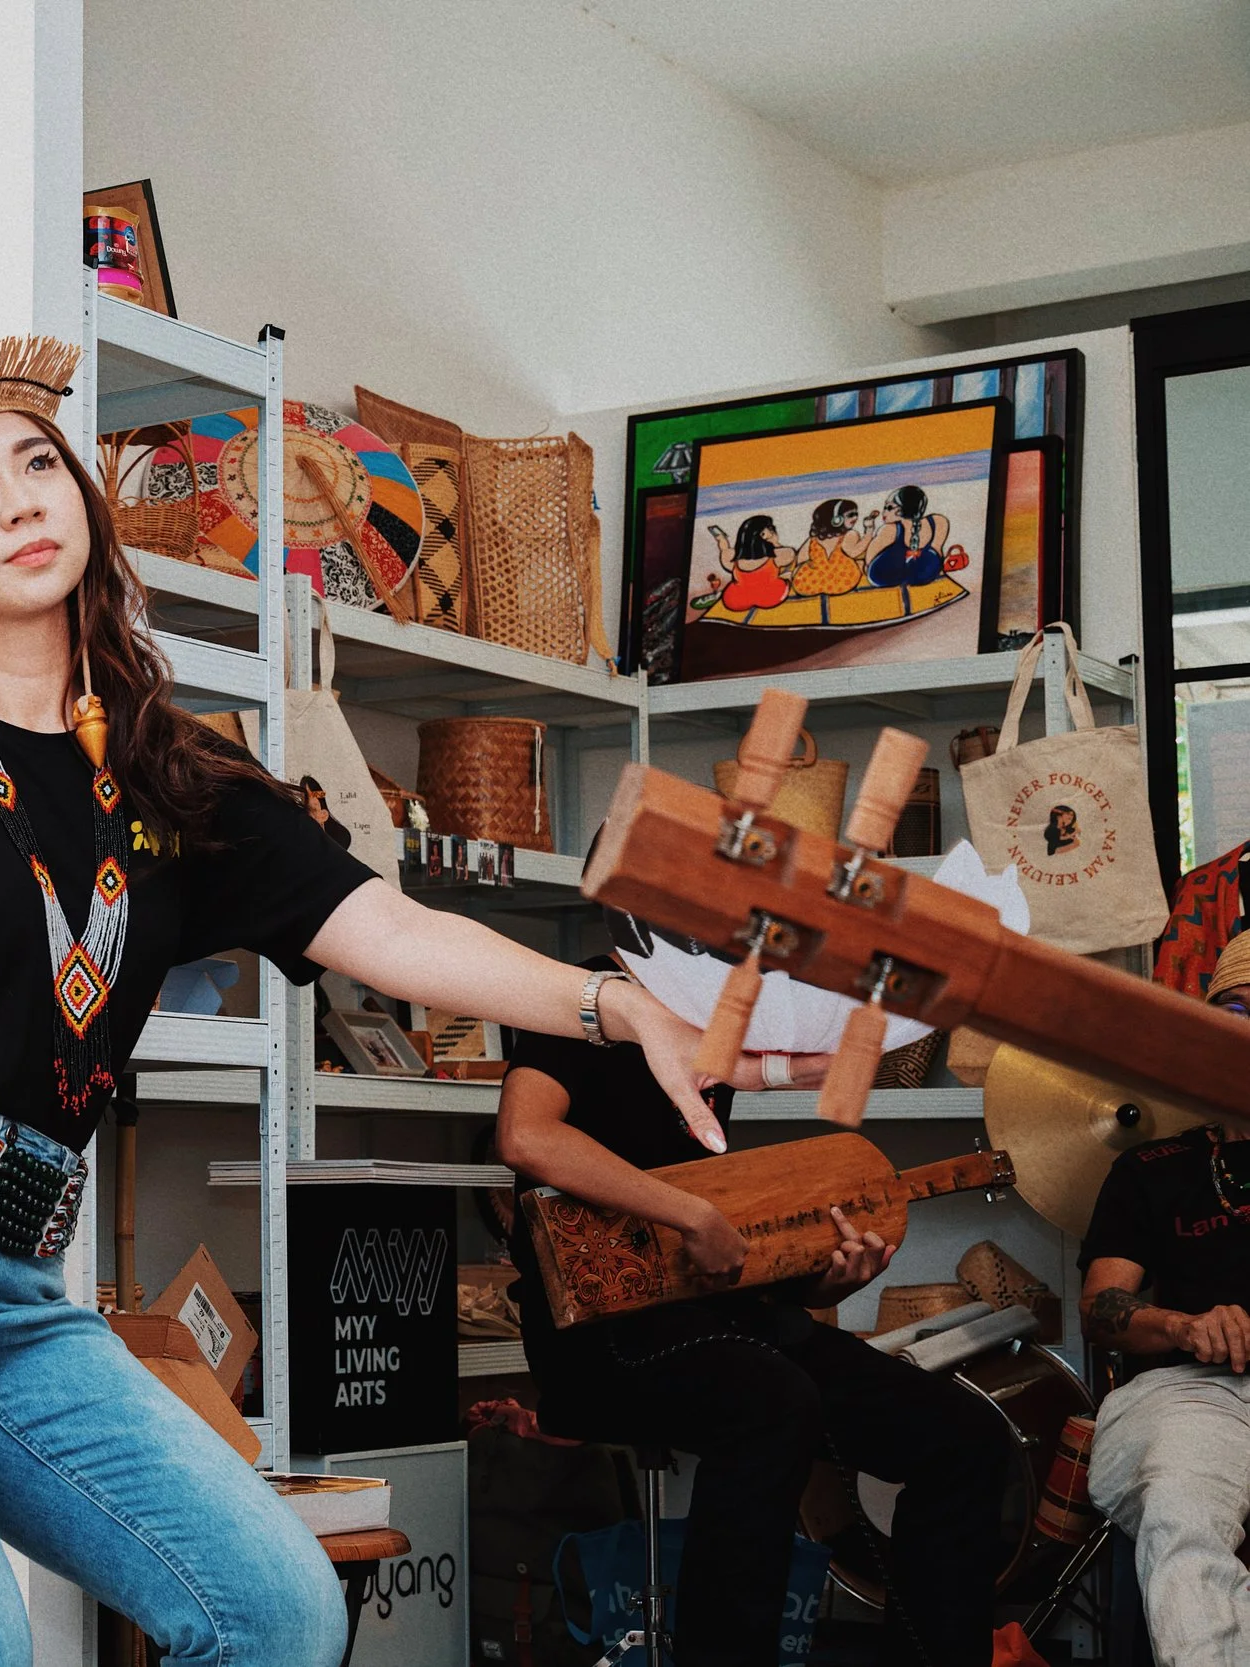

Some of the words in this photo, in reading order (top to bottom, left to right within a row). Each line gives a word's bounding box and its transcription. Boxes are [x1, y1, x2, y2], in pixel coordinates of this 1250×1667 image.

[1006, 778, 1044, 828] NEVER
[1048, 772, 1112, 811] FORGET
[1007, 844, 1079, 886] KELUPAN
[335, 1314, 378, 1341] MYY
[335, 1346, 401, 1374] LIVING
[334, 1379, 387, 1408] ARTS
